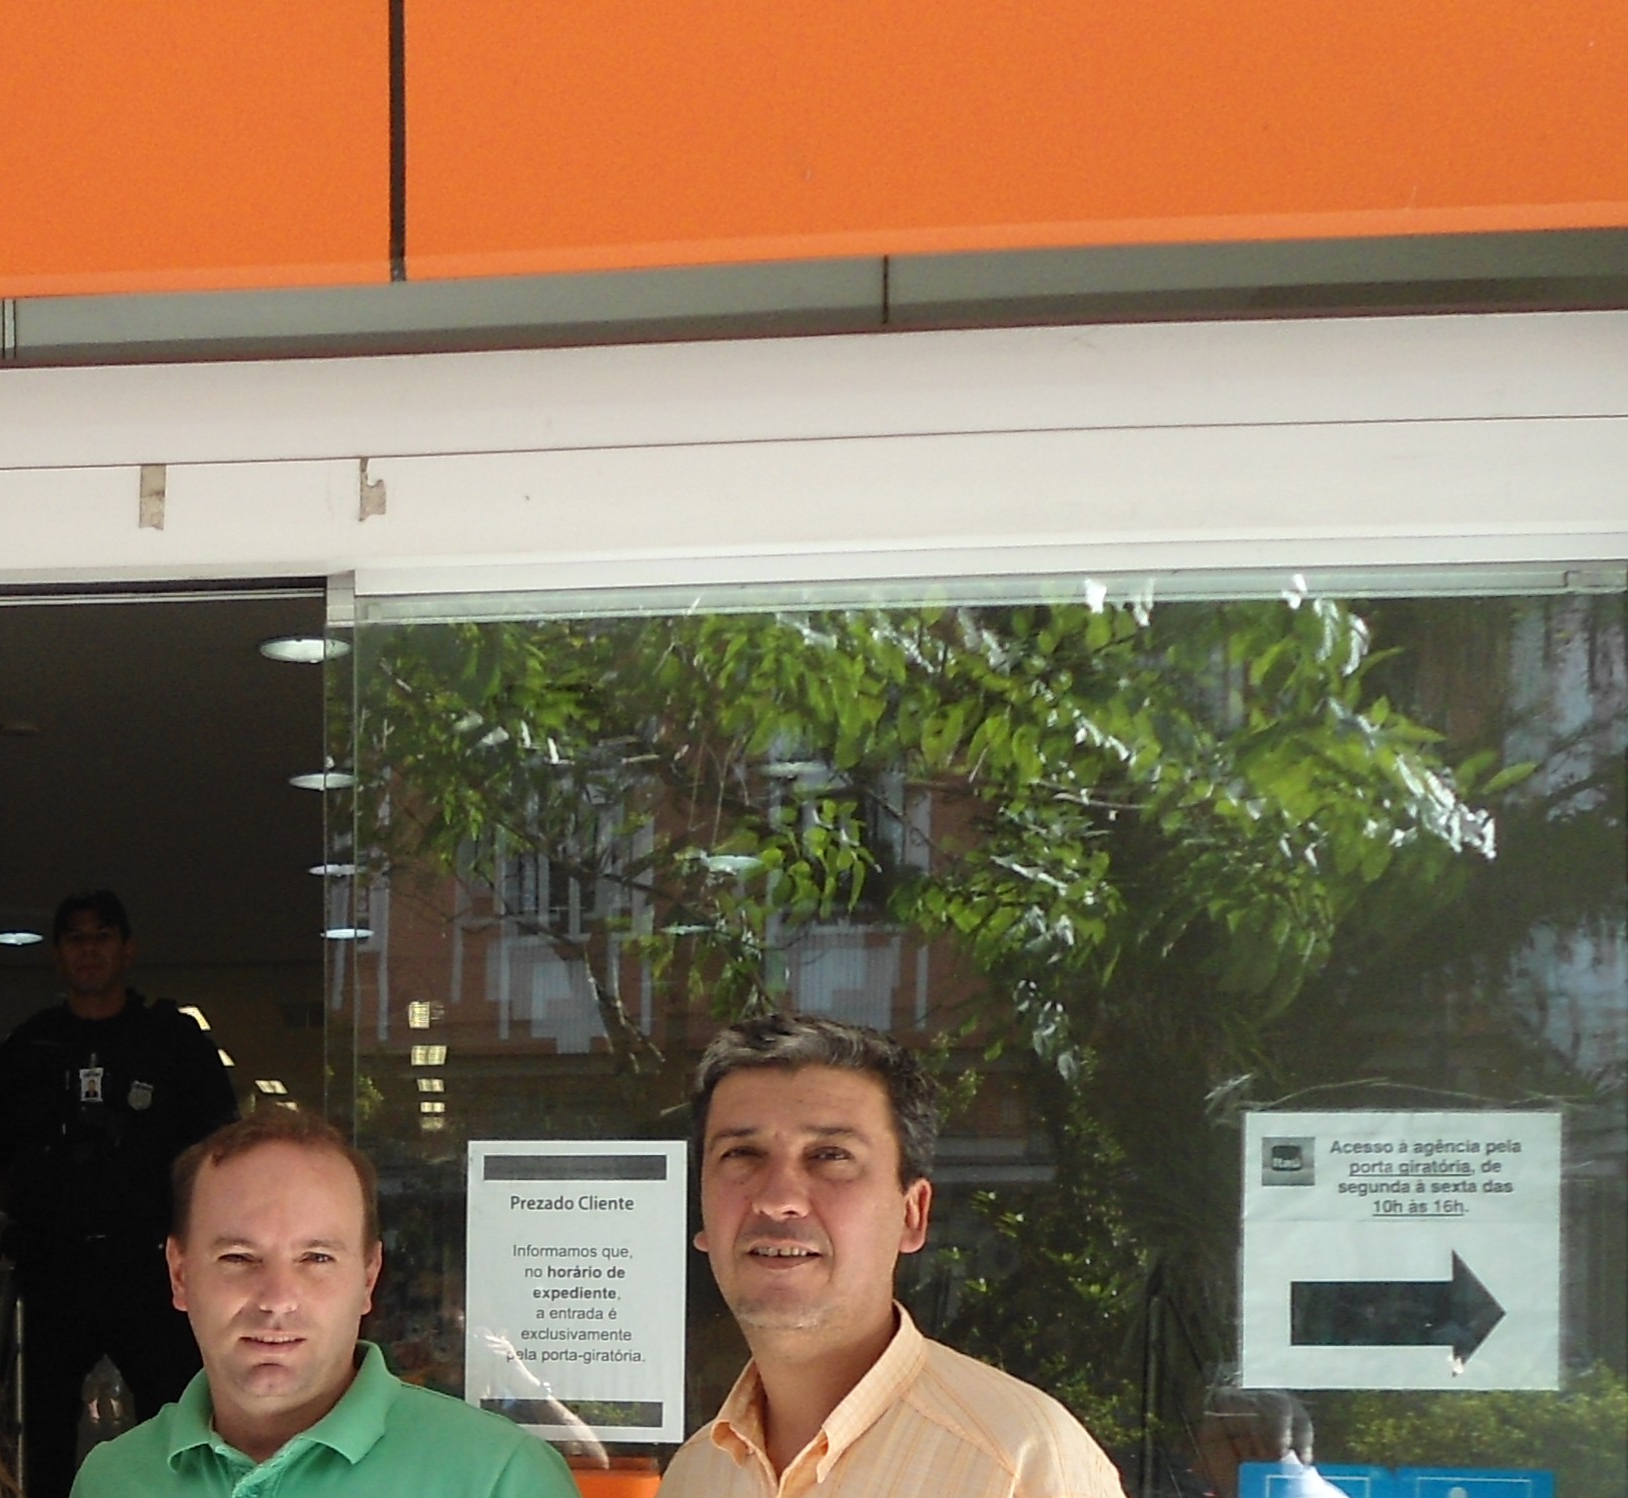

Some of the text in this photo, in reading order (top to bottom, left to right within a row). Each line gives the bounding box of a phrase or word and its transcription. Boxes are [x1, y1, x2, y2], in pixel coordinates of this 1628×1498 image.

[1329, 1140, 1394, 1154] Acesso
[1413, 1139, 1481, 1157] agência
[1485, 1139, 1522, 1156] pela
[1349, 1161, 1393, 1176] porta
[1480, 1160, 1502, 1173] de
[1337, 1180, 1411, 1197] segunda
[1430, 1180, 1477, 1194] sexta
[1482, 1179, 1514, 1194] das
[509, 1195, 635, 1211] Prezado Cliente
[1372, 1200, 1403, 1214] 10h
[1433, 1200, 1470, 1214] 16h.
[512, 1244, 598, 1258] Informamos
[524, 1265, 626, 1279] no horário de
[535, 1306, 617, 1320] a entrada é
[520, 1327, 633, 1342] exclusivamente
[541, 1349, 647, 1365] porta-giratória.
